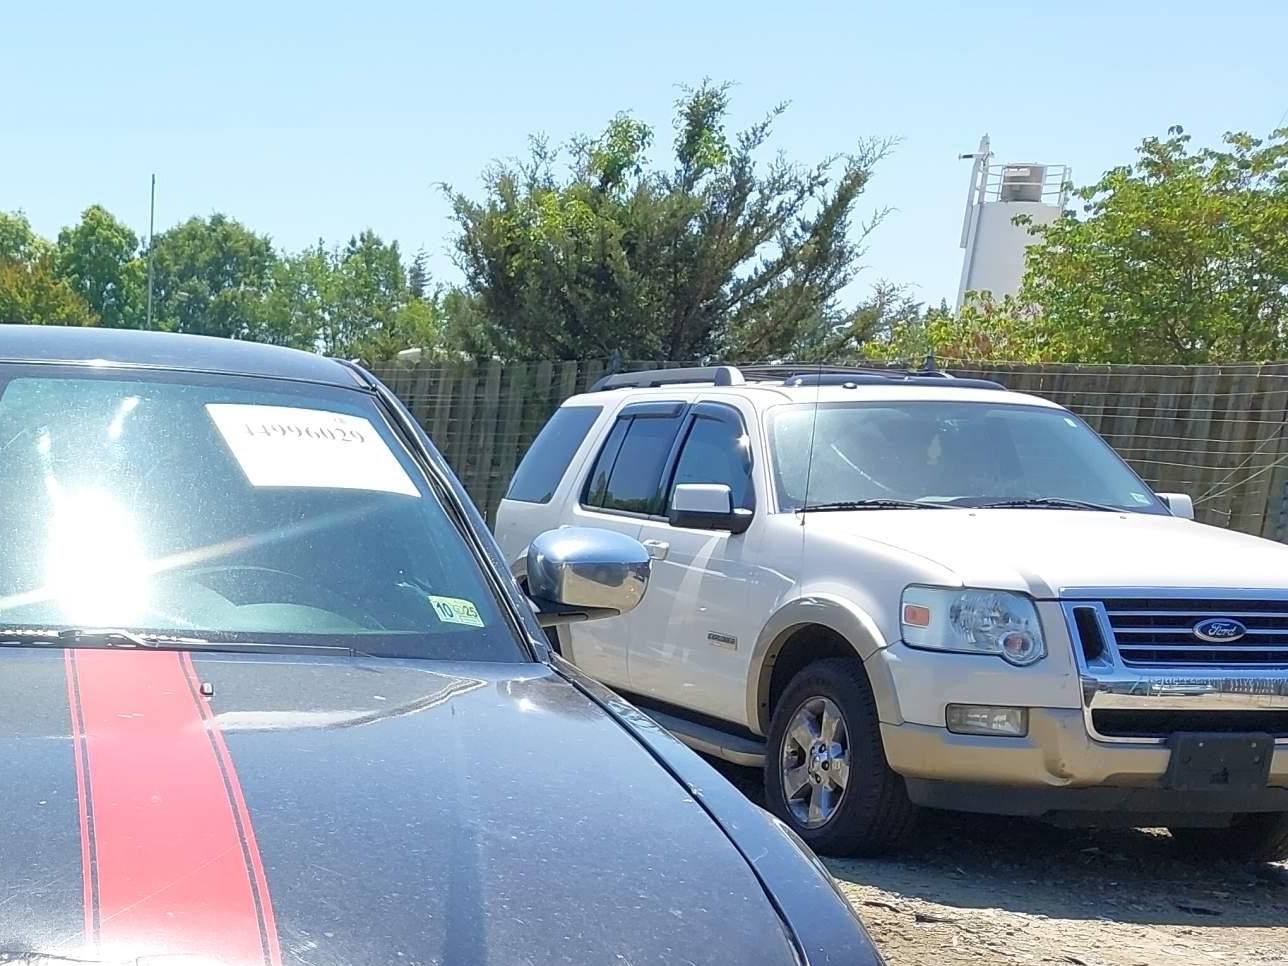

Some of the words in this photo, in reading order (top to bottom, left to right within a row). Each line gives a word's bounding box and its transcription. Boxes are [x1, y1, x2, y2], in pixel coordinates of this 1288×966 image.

[437, 602, 454, 617] 10
[462, 605, 478, 617] 25
[1208, 622, 1238, 636] Ford
